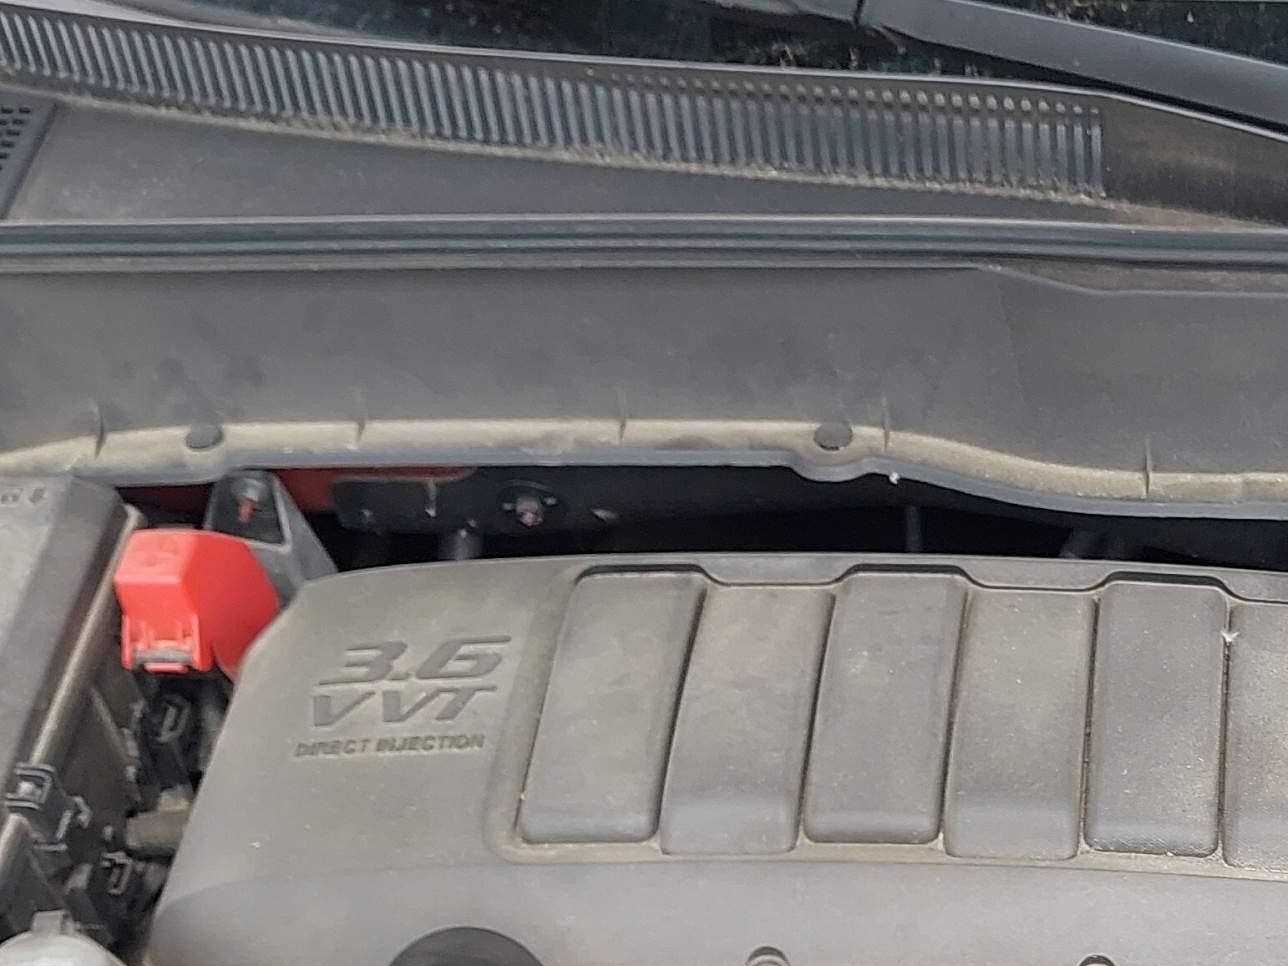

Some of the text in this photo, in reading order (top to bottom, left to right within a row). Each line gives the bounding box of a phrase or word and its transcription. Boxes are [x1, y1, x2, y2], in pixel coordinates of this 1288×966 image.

[317, 635, 512, 685] 3.6
[313, 685, 498, 727] VVT
[295, 734, 485, 757] DIRECT INJECTION
